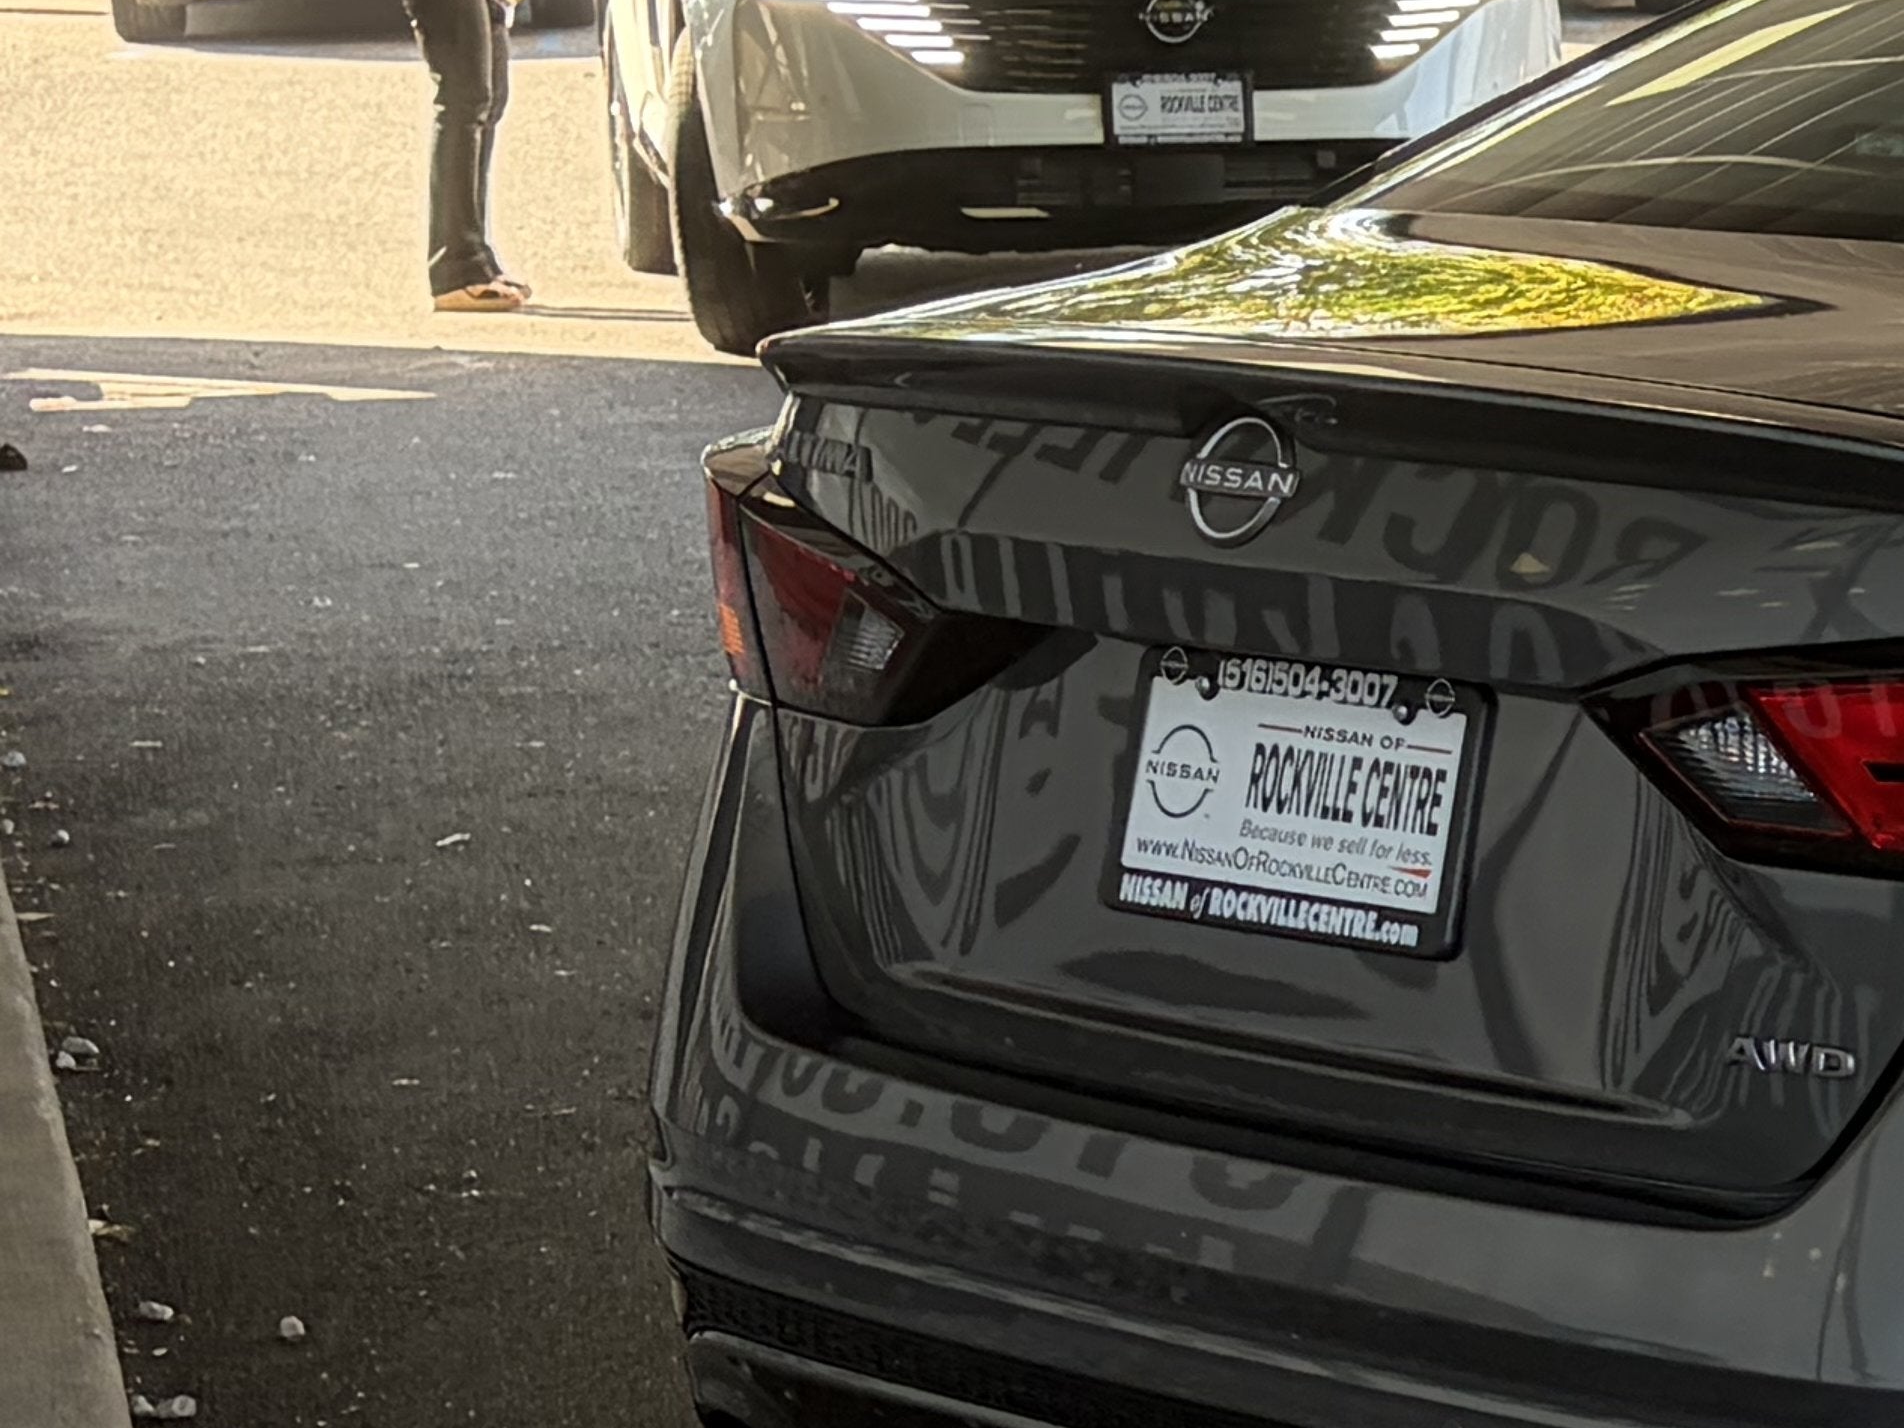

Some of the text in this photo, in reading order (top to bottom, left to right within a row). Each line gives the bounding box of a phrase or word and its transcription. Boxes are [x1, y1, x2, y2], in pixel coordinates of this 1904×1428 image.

[1179, 461, 1295, 495] NISSAN
[1302, 725, 1405, 751] NISSAN OF
[1145, 759, 1220, 784] NISSAN
[1245, 742, 1448, 837] ROCKVILLE CENTRE
[1238, 820, 1306, 849] Because
[1310, 834, 1334, 850] we
[1339, 838, 1368, 858] sell
[1370, 839, 1394, 860] for
[1119, 873, 1419, 947] NISSAN of ROCKVILLECENTRE.com
[1726, 1036, 1856, 1077] AWD
